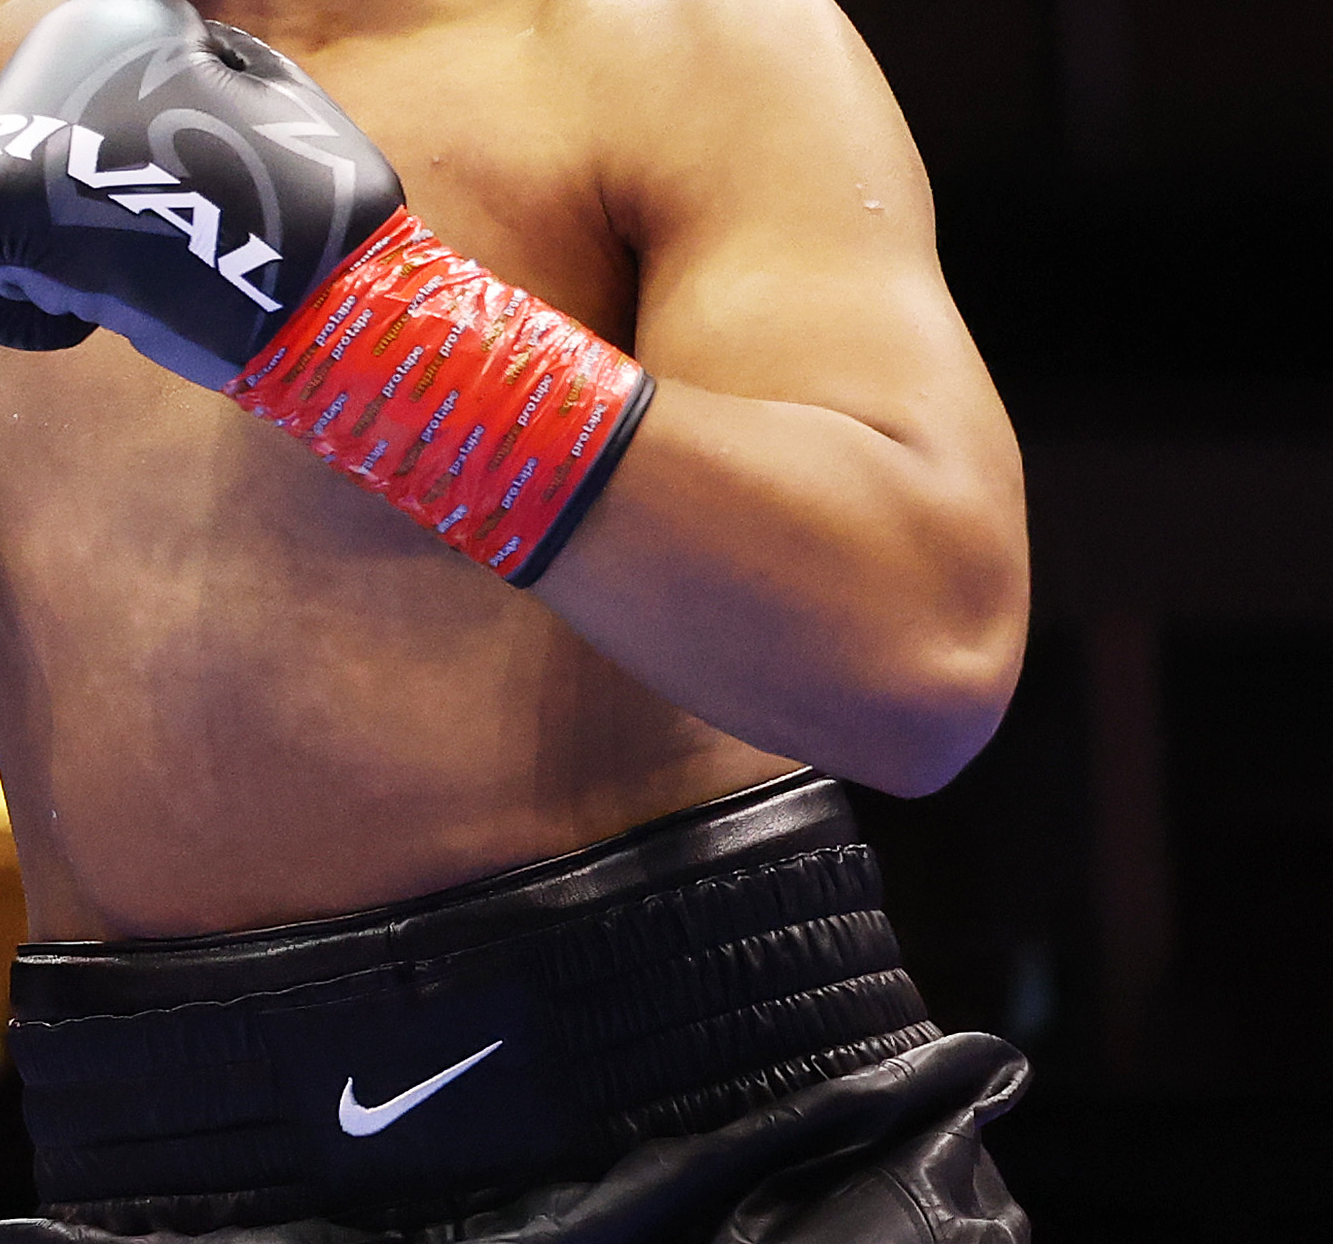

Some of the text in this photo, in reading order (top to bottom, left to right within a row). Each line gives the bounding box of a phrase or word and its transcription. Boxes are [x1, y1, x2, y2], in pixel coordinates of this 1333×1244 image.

[329, 296, 355, 323] tape
[332, 309, 372, 359] pro tape
[440, 334, 457, 356] pro
[382, 347, 423, 397] pro tape
[422, 391, 458, 442] pro tape
[518, 402, 536, 425] pro
[530, 375, 551, 402] tape
[460, 426, 483, 453] tape
[572, 433, 589, 456] pro
[583, 404, 606, 432] tape
[502, 458, 536, 508] pro tape
